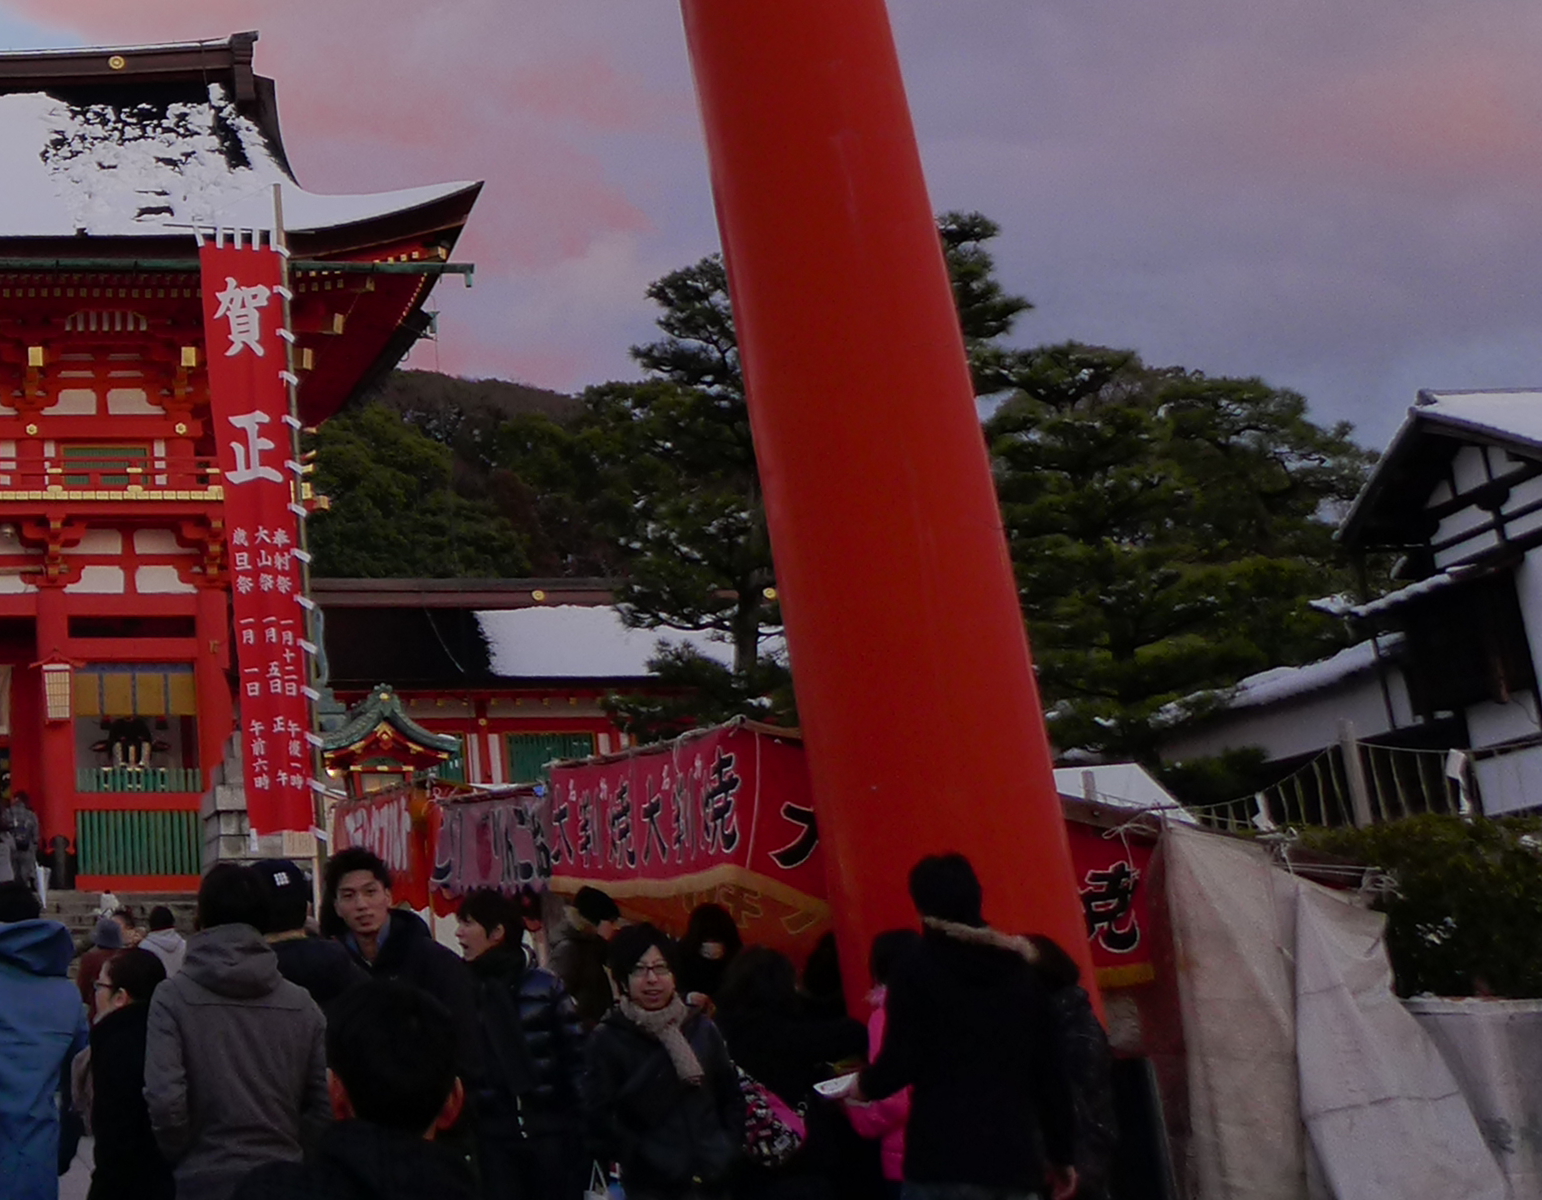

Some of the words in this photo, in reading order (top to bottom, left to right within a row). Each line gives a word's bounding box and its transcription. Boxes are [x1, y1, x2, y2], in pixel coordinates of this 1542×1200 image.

[213, 275, 283, 485] 賀正
[232, 527, 254, 594] 歳旦祭
[254, 525, 275, 592] 大山祭
